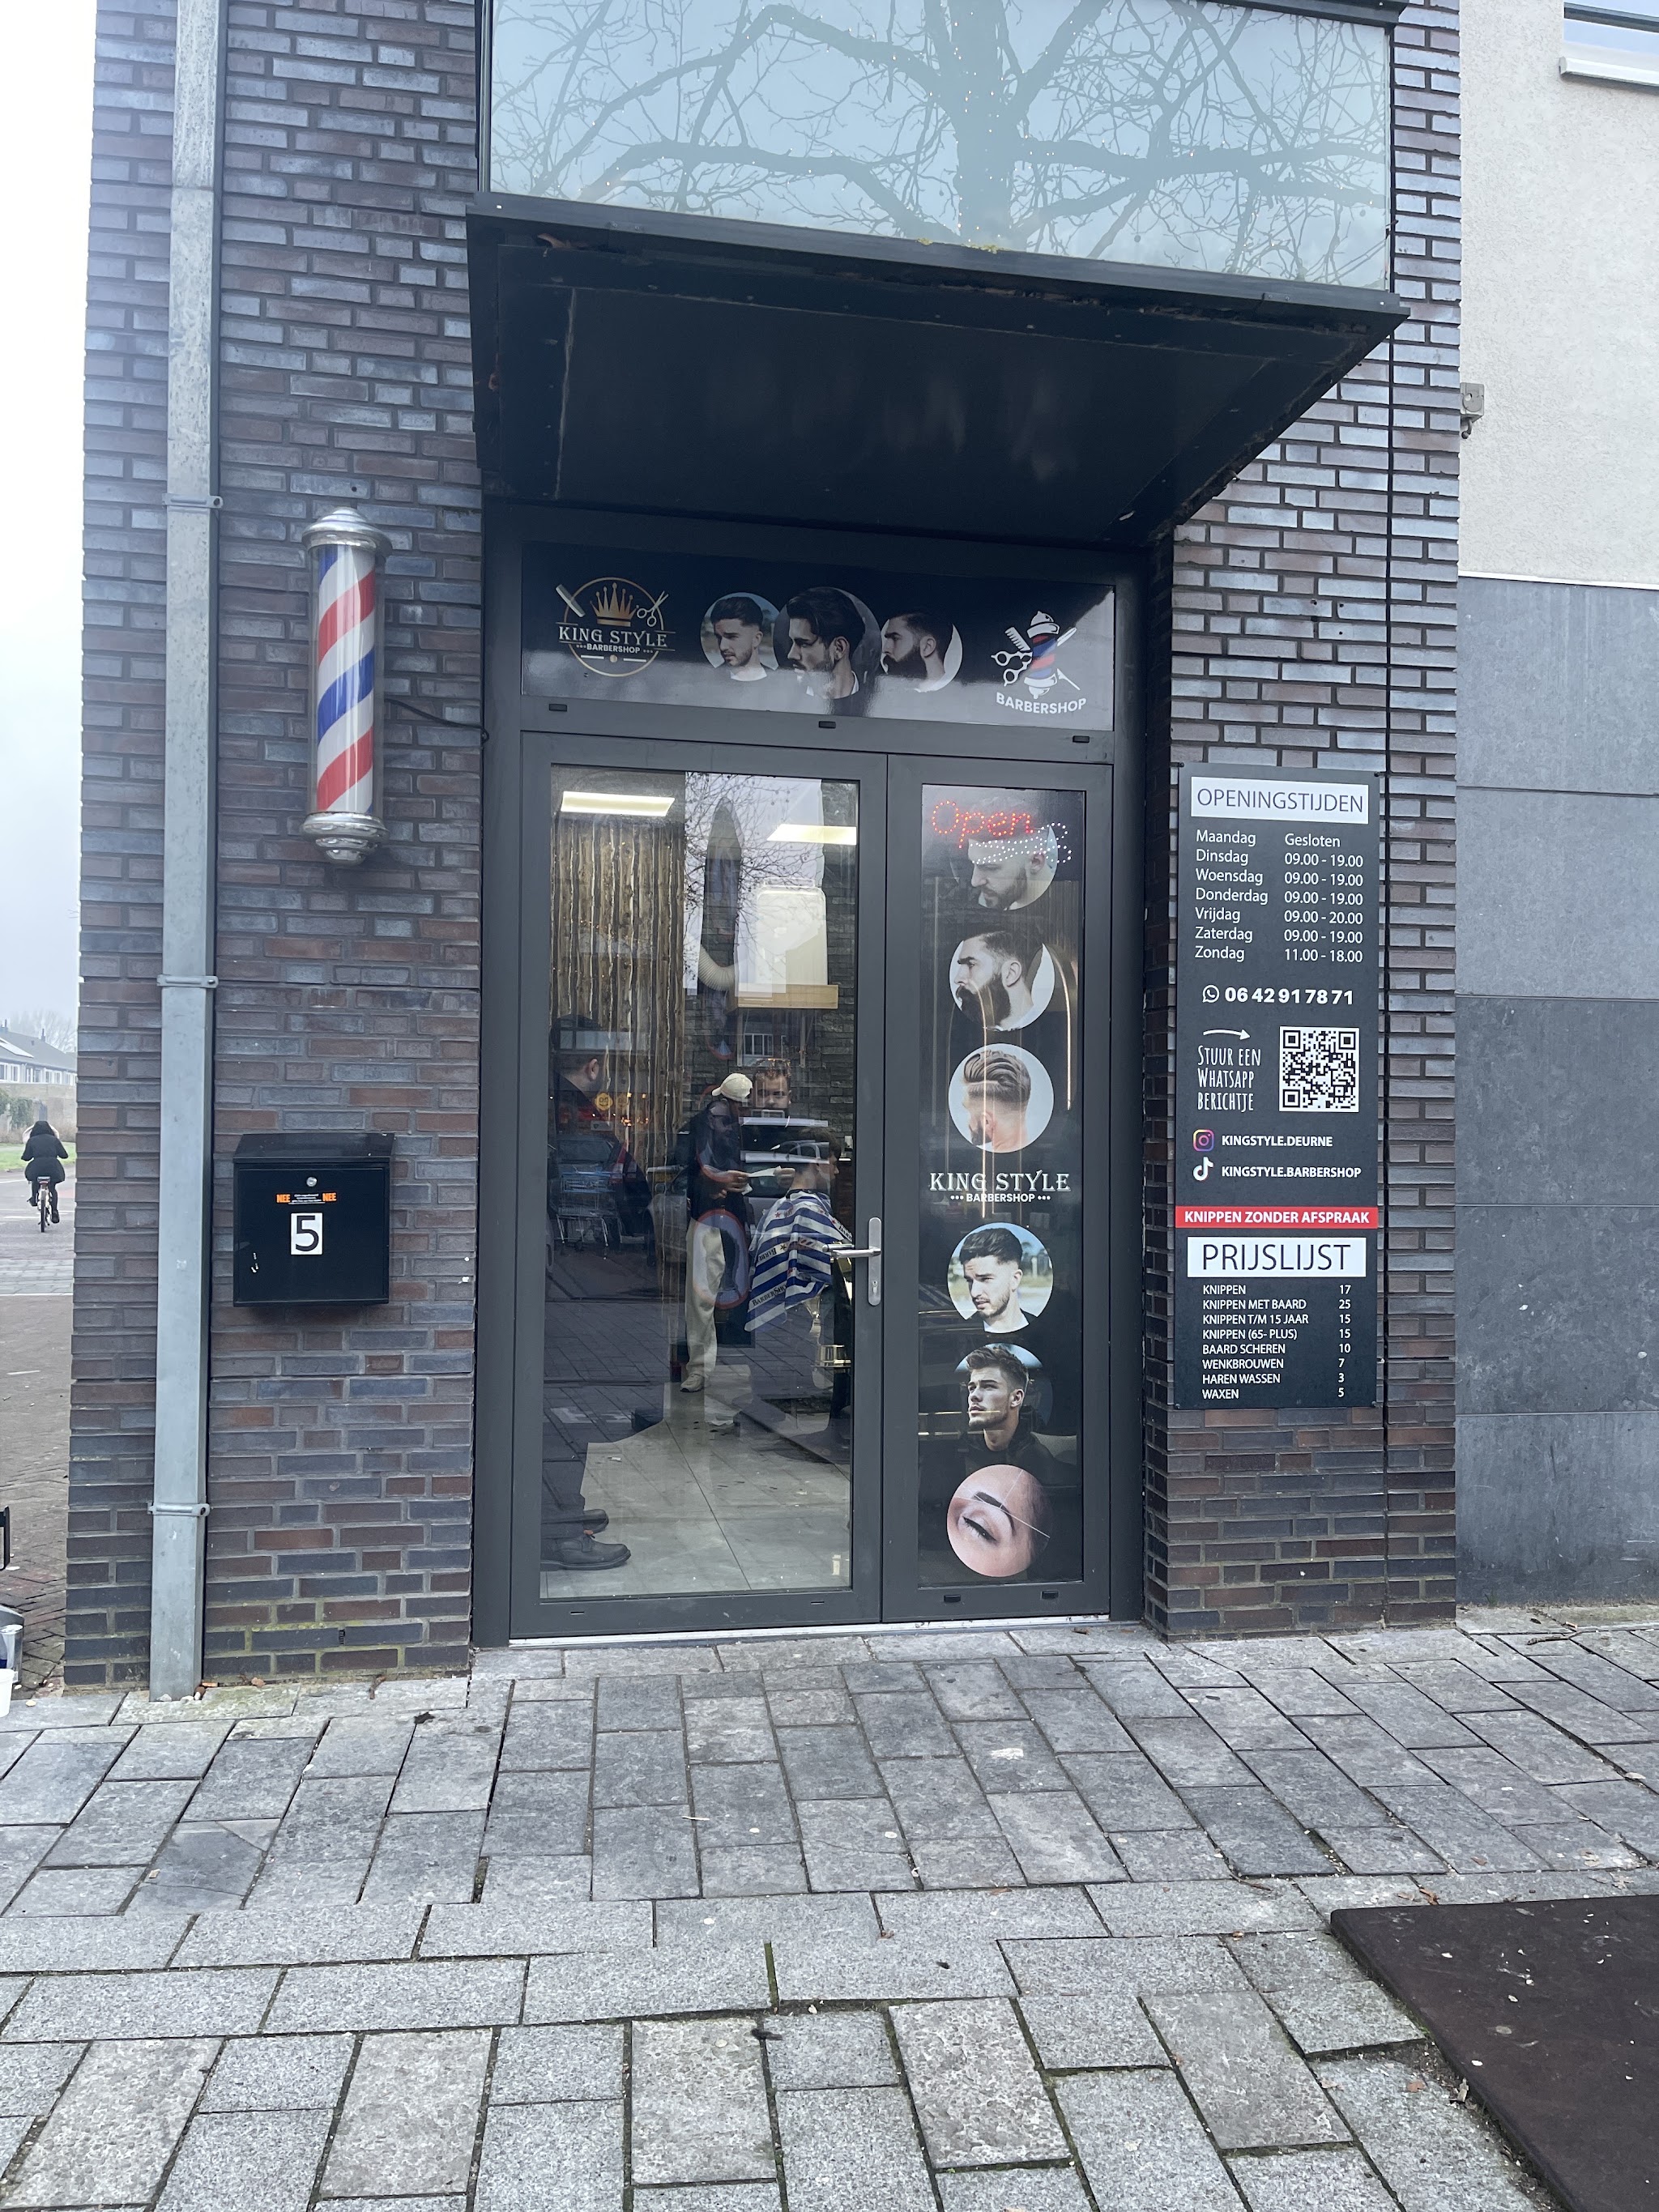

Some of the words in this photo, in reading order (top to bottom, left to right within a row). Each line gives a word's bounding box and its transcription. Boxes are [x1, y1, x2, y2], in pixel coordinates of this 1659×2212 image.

[559, 626, 603, 642] KING
[610, 630, 667, 647] STYLE
[586, 643, 640, 653] BARBERSHOP
[996, 692, 1087, 714] BARBERSHOP
[1197, 788, 1363, 812] OPENINGSTIJDEN
[932, 800, 1034, 849] Open
[1196, 829, 1256, 846] Maandag
[1285, 833, 1341, 847] Gesloten
[1196, 849, 1248, 866] Dinsdag
[1285, 853, 1319, 866] 09.00
[1330, 855, 1363, 867] 19.00
[1196, 867, 1264, 886] Woensdag
[1285, 872, 1319, 884] 09.00
[1330, 874, 1363, 886] 19.00
[1196, 888, 1269, 905] Donderdag
[1285, 891, 1319, 904] 09.00
[1330, 893, 1363, 906] 19.00
[1195, 907, 1241, 923] Vrijdag
[1285, 910, 1319, 923] 09.00
[1329, 912, 1363, 924] 20.00
[1195, 927, 1253, 943] Zaterdag
[1285, 929, 1319, 942] 09.00
[1330, 931, 1363, 944] 19.00
[1195, 946, 1245, 962] Zondag
[1285, 948, 1319, 961] 11.00
[1330, 950, 1363, 962] 18.00
[1225, 987, 1248, 1002] 06
[1252, 987, 1275, 1003] 42
[1278, 988, 1300, 1004] 91
[1305, 989, 1328, 1004] 78
[1331, 990, 1353, 1005] 71
[1197, 1046, 1233, 1066] STUUR
[1197, 1092, 1254, 1113] BERICHTJE
[1222, 1136, 1333, 1147] KINGSTYLE.DEURNE
[930, 1173, 987, 1191] KING
[996, 1170, 1072, 1191] STYLE
[1222, 1166, 1362, 1178] KINGSTYLE.BARBERSHOP
[966, 1193, 1035, 1203] BARBERSHOP
[1184, 1211, 1242, 1223] KNIPPEN
[1244, 1212, 1299, 1223] ZONDER
[1301, 1212, 1370, 1224] AFSPRAAK
[295, 1216, 319, 1251] 5
[1203, 1244, 1351, 1271] PRIJSLIJST
[752, 1284, 787, 1306] BARBERSHO
[1203, 1285, 1246, 1295] KNIPPEN
[1339, 1285, 1351, 1294] 17
[1203, 1300, 1246, 1310] KNIPPEN
[1248, 1299, 1269, 1309] MET
[1272, 1299, 1307, 1309] BAARD
[1339, 1299, 1351, 1309] 25
[1203, 1315, 1246, 1324] KNIPPEN
[1247, 1315, 1267, 1324] T/M
[1270, 1315, 1282, 1324] 15
[1283, 1315, 1309, 1325] JAAR
[1339, 1314, 1351, 1323] 15
[1203, 1329, 1246, 1340] KNIPPEN
[1248, 1329, 1267, 1340] (65-
[1269, 1329, 1298, 1340] PLUS)
[1339, 1329, 1351, 1339] 15
[1203, 1345, 1238, 1354] BAARD
[1240, 1344, 1286, 1354] SCHEREN
[1339, 1344, 1351, 1353] 10
[1202, 1359, 1284, 1369] WENKBROUWEN
[1338, 1358, 1345, 1368] 7
[1203, 1374, 1238, 1384] HAREN
[1239, 1374, 1281, 1383] WASSEN
[1338, 1373, 1345, 1383] 3
[1202, 1389, 1239, 1400] WAXEN
[1338, 1387, 1345, 1397] 5
